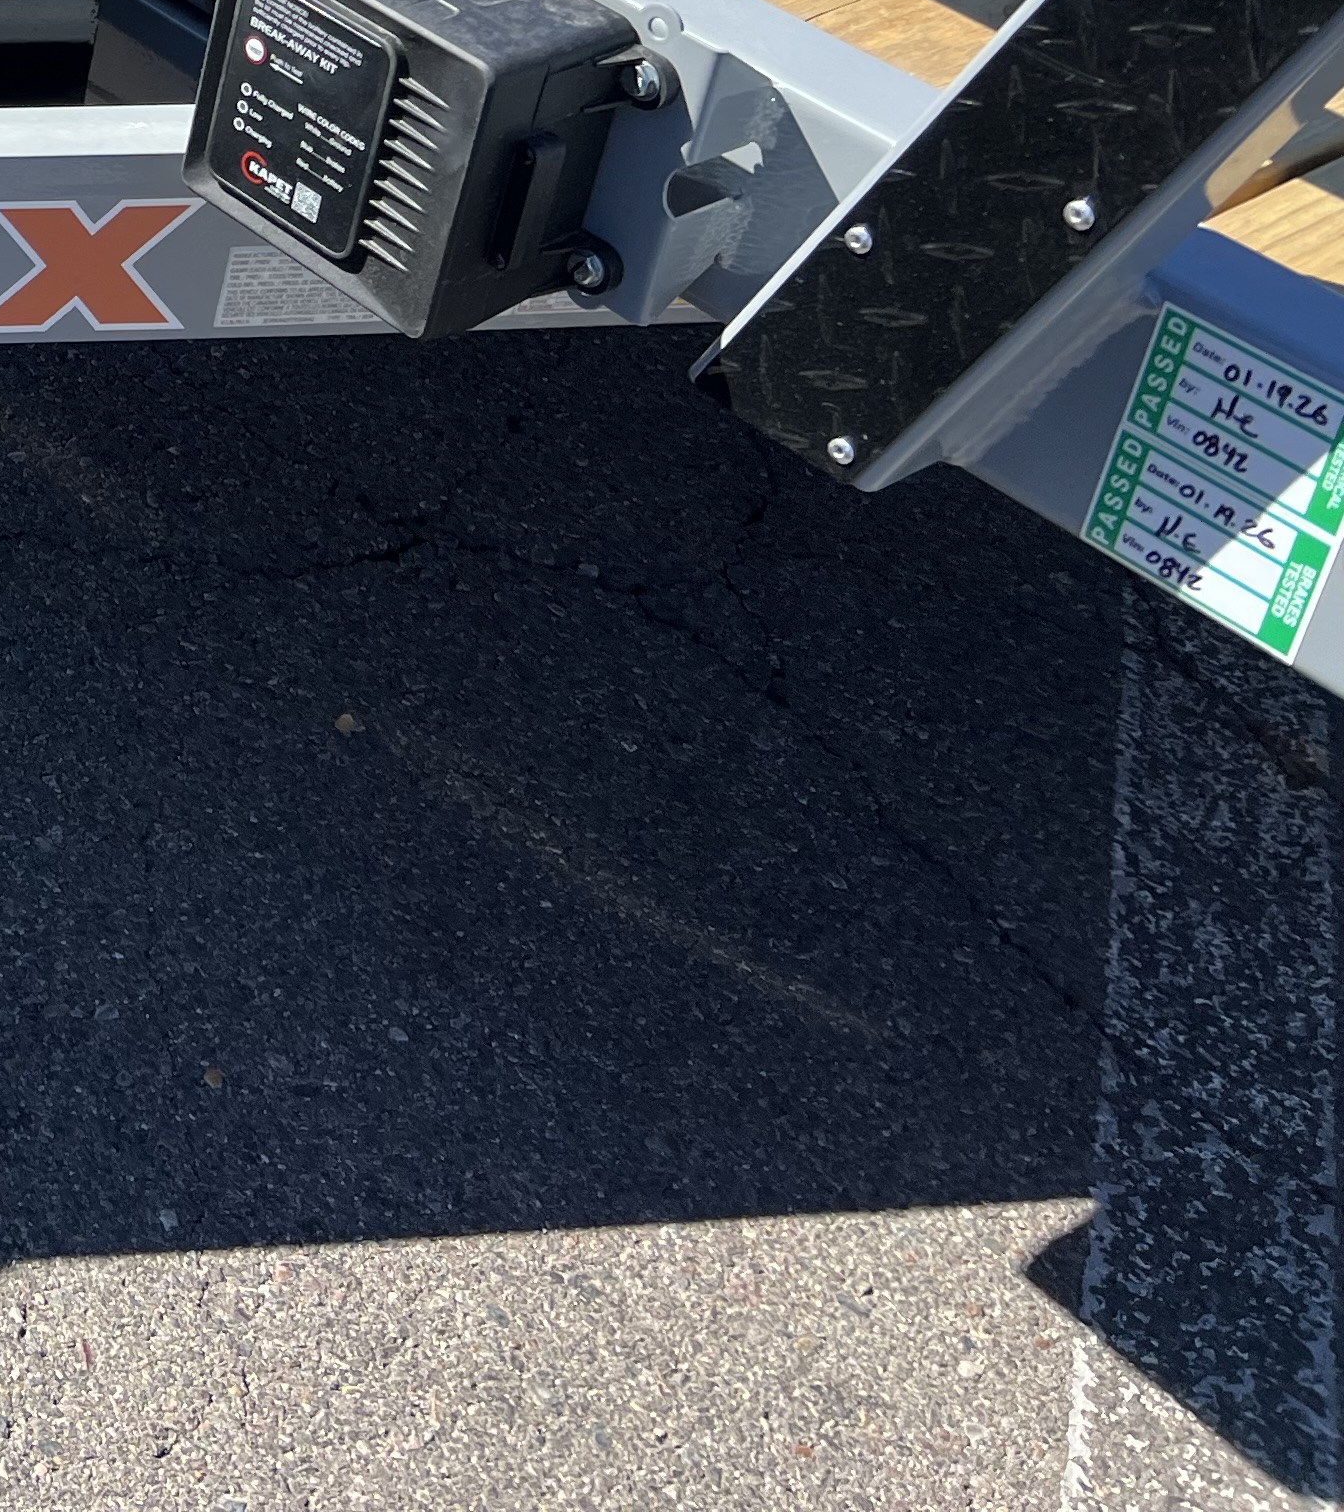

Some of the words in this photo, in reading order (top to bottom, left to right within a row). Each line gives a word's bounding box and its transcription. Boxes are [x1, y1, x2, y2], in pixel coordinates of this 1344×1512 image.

[249, 16, 320, 64] BREAK-AWAY
[319, 57, 338, 74] KIT
[316, 115, 340, 135] COLOR
[249, 160, 293, 194] KAPET
[1192, 341, 1226, 365] Date:
[1134, 316, 1188, 427] PASSED
[1179, 378, 1200, 395] by:
[1167, 414, 1190, 435] Vin:
[1147, 463, 1180, 488] Date:
[1322, 442, 1344, 492] ESTED
[1091, 438, 1142, 545] PASSED
[1134, 497, 1153, 514] by:
[1122, 533, 1145, 553] Vin:
[1271, 560, 1303, 617] TESTED
[1284, 564, 1317, 628] BRAKES
